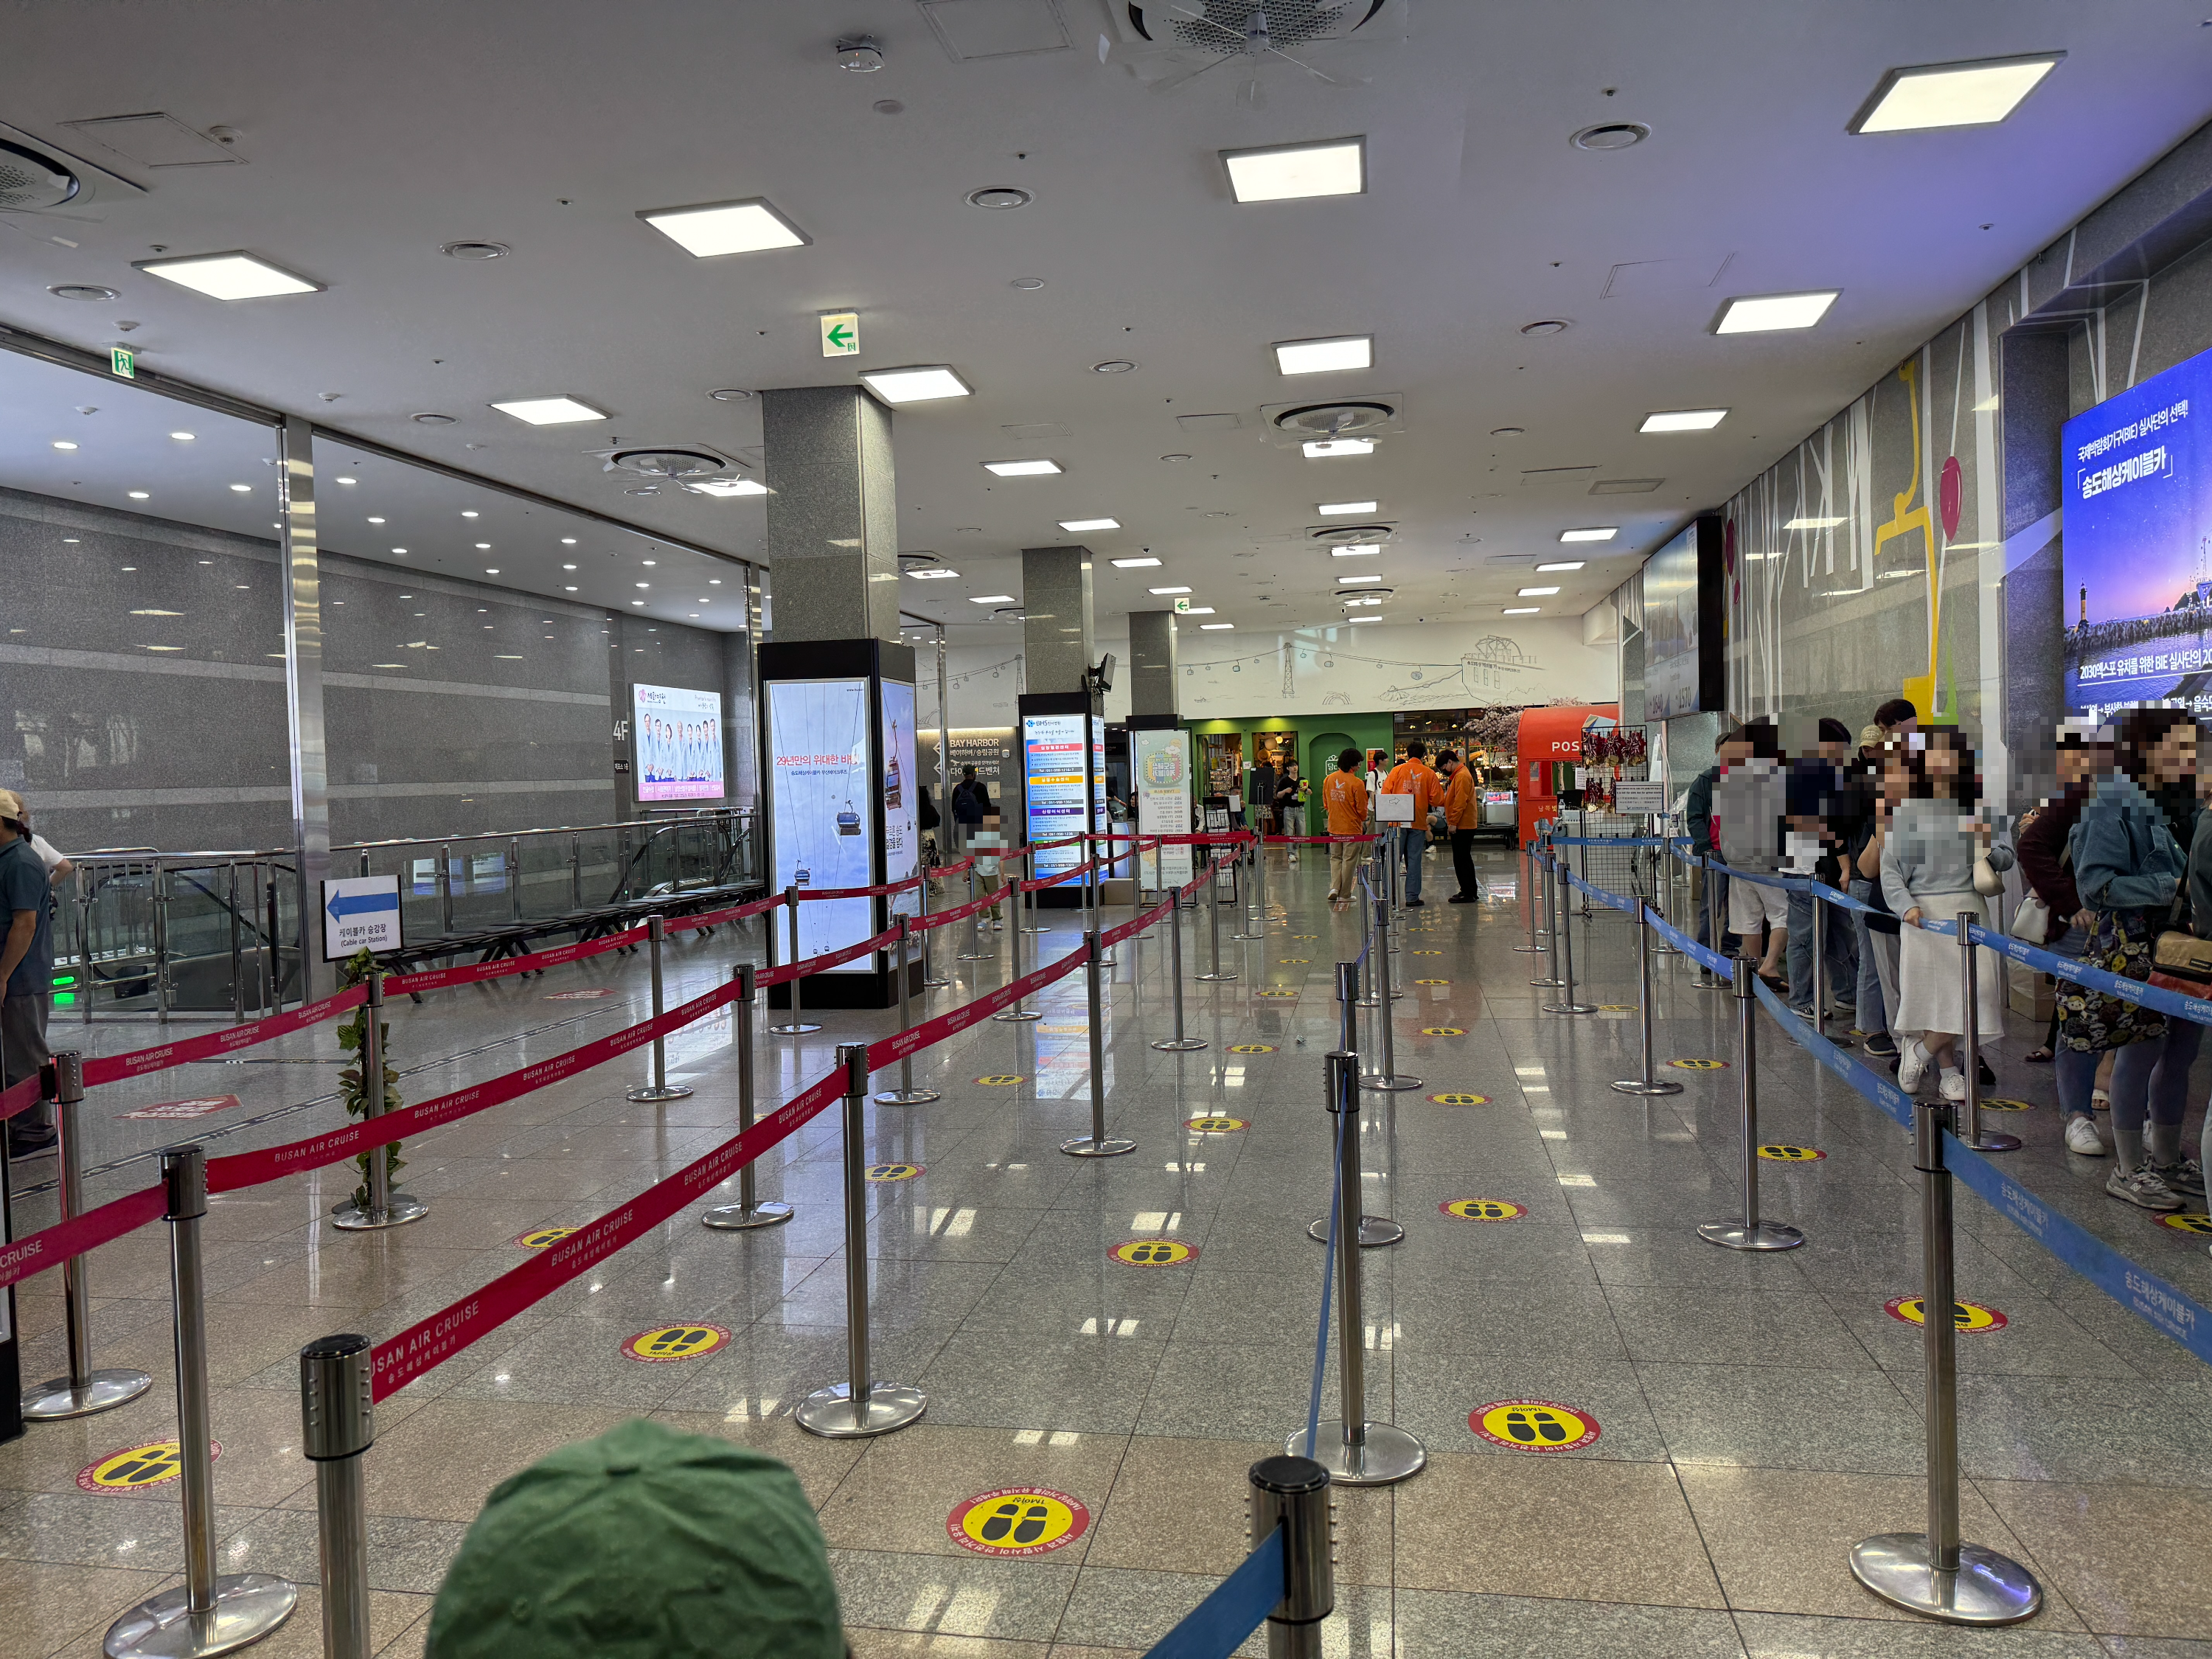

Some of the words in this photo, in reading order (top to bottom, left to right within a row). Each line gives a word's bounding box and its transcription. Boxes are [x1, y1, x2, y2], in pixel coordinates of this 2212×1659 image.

[2077, 422, 2138, 462] 국제박람회기구(BIE)
[2139, 407, 2168, 437] 실사단의
[2169, 399, 2188, 423] 선택!
[2079, 661, 2116, 680] 2030엑스포
[2117, 658, 2138, 676] 유치를
[2138, 655, 2154, 674] 위한
[2155, 654, 2168, 669] BIE
[2169, 648, 2202, 670] 실사단의
[613, 720, 628, 741] 4F
[950, 740, 965, 748] BAY
[966, 738, 999, 747] HARBOR
[1551, 741, 1580, 752] POS
[776, 755, 811, 766] 29년만의
[813, 754, 839, 765] 위대한
[950, 749, 973, 757] 베이하버
[339, 926, 366, 937] 케이블카
[367, 923, 386, 934] 승강장
[341, 939, 358, 947] (Cable
[368, 935, 388, 943] Station)
[476, 964, 491, 973] BUSAN
[500, 961, 515, 969] CRUISE
[402, 976, 418, 985] BUSAN
[428, 973, 446, 981] CRUISE
[298, 1009, 312, 1019] BUSAN
[318, 1001, 332, 1012] CRUISE
[220, 1032, 236, 1043] BUSAN
[235, 1030, 243, 1038] AIR
[243, 1026, 260, 1037] CRUISE
[610, 1034, 627, 1046] BUSAN
[627, 1031, 636, 1039] AIR
[636, 1023, 653, 1035] CRUISE
[891, 1038, 903, 1050] BUSAN
[908, 1030, 921, 1043] CRUISE
[125, 1056, 145, 1066] BUSAN
[145, 1054, 155, 1062] AIR
[154, 1047, 173, 1060] CRUISE
[523, 1068, 543, 1081] BUSAN
[544, 1064, 554, 1074] AIR
[555, 1055, 576, 1068] CRUISE
[414, 1104, 439, 1119] BUSAN
[441, 1099, 453, 1110] AIR
[455, 1090, 480, 1105] CRUISE
[778, 1108, 796, 1124] BUSAN
[796, 1100, 804, 1113] AIR
[805, 1088, 822, 1105] CRUISE
[274, 1148, 307, 1162] BUSAN
[309, 1142, 324, 1154] AIR
[328, 1130, 360, 1149] CRUISE
[684, 1164, 706, 1186] BUSAN
[708, 1155, 720, 1171] AIR
[720, 1141, 742, 1163] CRUISE
[552, 1241, 582, 1267] BUSAN
[586, 1231, 601, 1248] AIR
[603, 1208, 633, 1236] CRUISE
[0, 1239, 43, 1268] CRUISE
[2125, 1270, 2195, 1331] 송도해상케이블카
[371, 1346, 404, 1377] USAN
[409, 1329, 431, 1353] AIR
[435, 1300, 479, 1338] CRUISE
[388, 1334, 456, 1384] 송도해상케이블카
[1499, 1440, 1541, 1451] 안전거리
[1544, 1441, 1582, 1452] 사람사이
[1012, 1497, 1046, 1506] 1M이상
[1033, 1488, 1060, 1498] 거리를
[1058, 1495, 1082, 1510] 1M이상
[950, 1523, 964, 1537] 유지!
[957, 1537, 995, 1554] 안전거리
[1046, 1533, 1074, 1548] 사람과
[999, 1546, 1043, 1555] 사람사이
